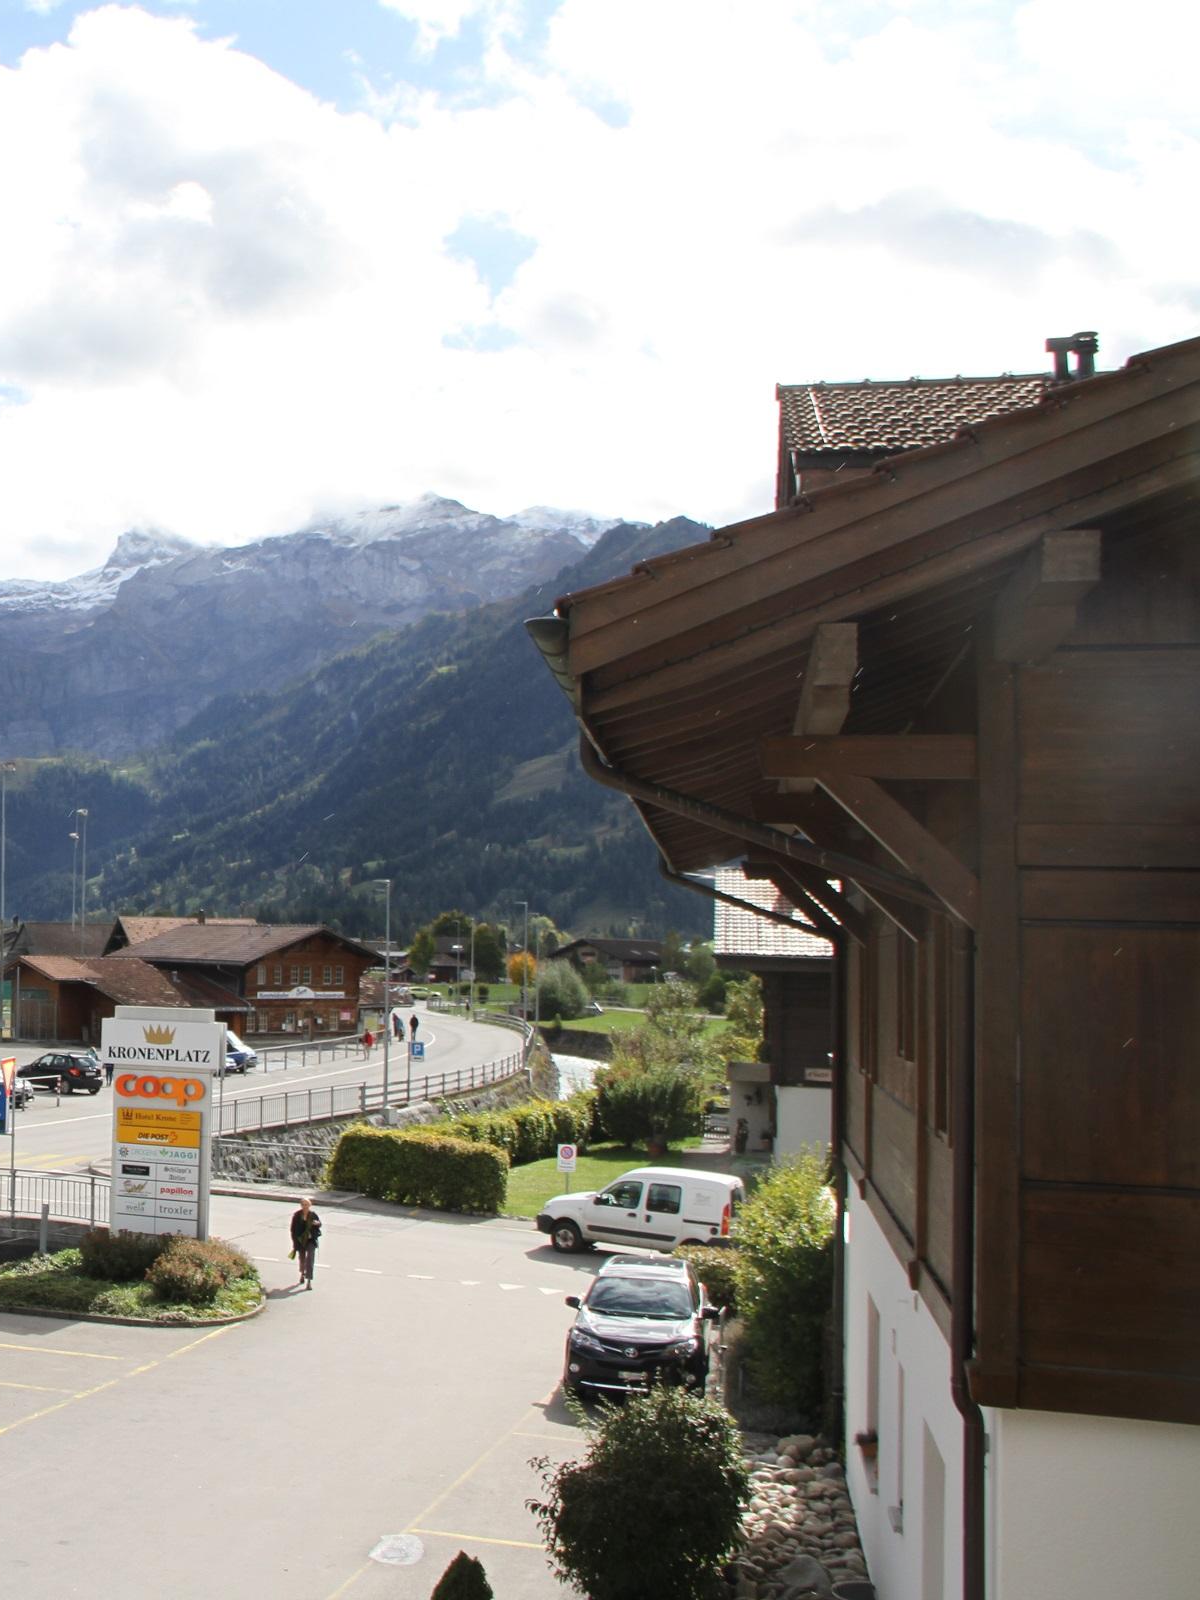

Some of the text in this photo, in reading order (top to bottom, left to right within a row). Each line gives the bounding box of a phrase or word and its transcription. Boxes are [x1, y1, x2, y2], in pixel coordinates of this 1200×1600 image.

[108, 1046, 210, 1063] KRONENPLATZ
[115, 1074, 205, 1106] coop
[135, 1112, 154, 1120] Hotel
[155, 1114, 177, 1122] Krone
[151, 1133, 169, 1141] POST
[169, 1151, 197, 1160] JAGGI
[160, 1187, 193, 1196] papillon
[159, 1205, 193, 1216] troxler
